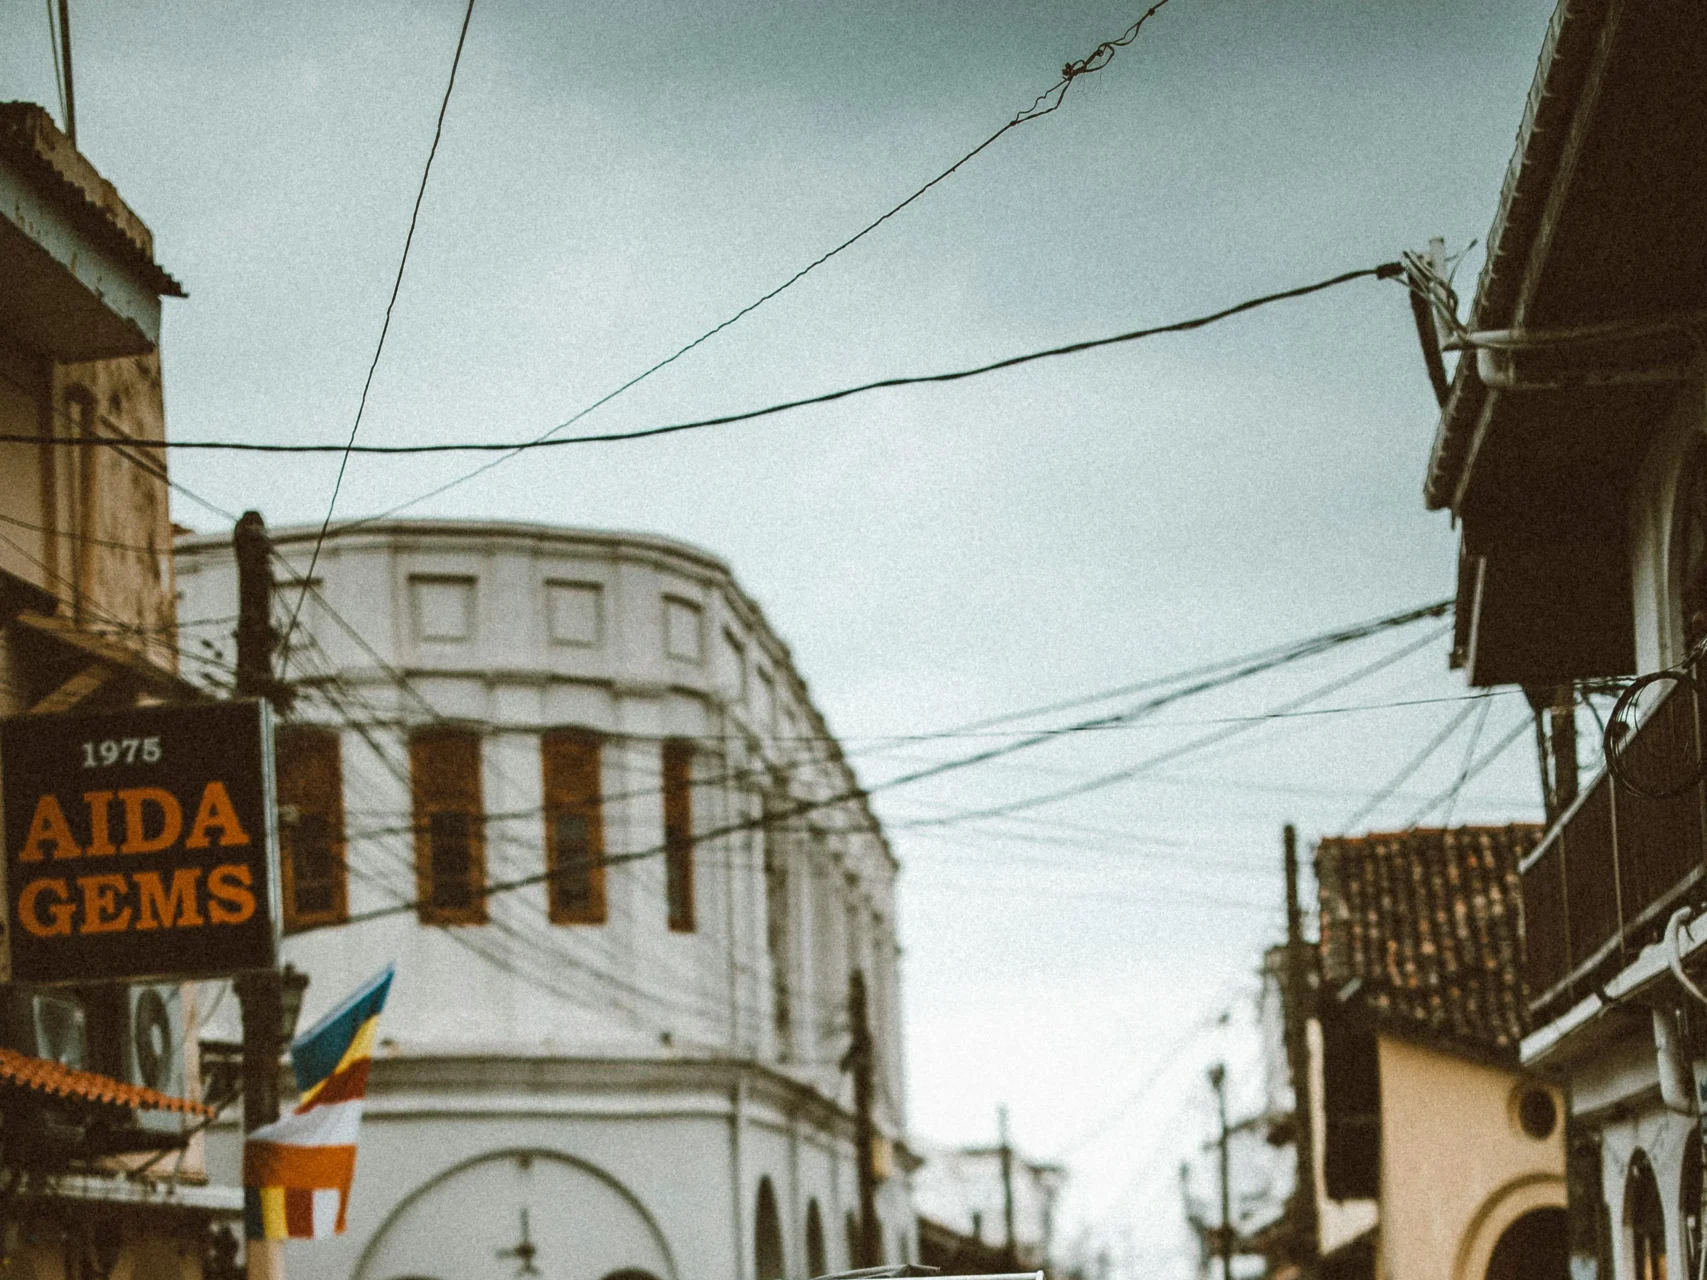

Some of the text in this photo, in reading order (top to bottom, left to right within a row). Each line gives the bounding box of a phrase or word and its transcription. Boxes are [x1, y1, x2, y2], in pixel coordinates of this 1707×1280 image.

[82, 737, 162, 768] 1975
[18, 780, 250, 862] AIDA
[18, 864, 256, 938] GEMS
